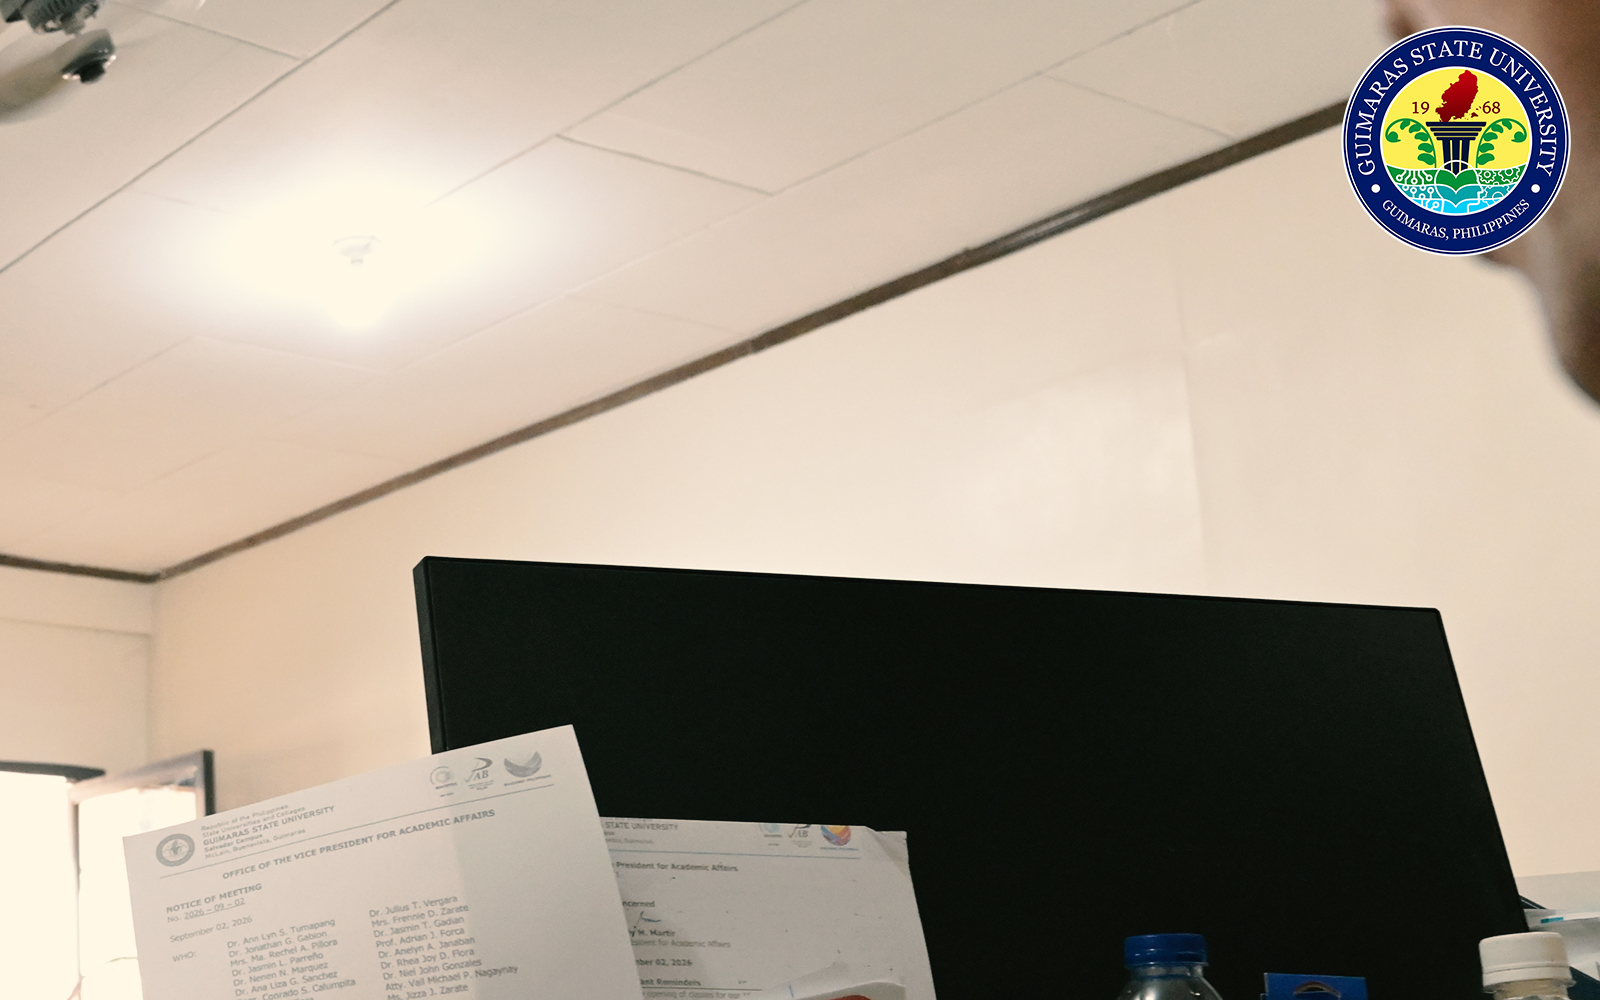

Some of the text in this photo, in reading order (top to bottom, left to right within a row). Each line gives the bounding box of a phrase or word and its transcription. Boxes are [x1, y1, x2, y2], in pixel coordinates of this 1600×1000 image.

[202, 830, 219, 838] State
[276, 807, 305, 817] Colleges
[203, 805, 334, 845] GUIMARAS STATE UNIVERSITY
[631, 822, 678, 830] UNIVERSITY
[205, 834, 262, 852] Salvador Campus
[222, 809, 495, 879] OFFICE OF THE VICE PRESIDENT FOR ACADEMIC AFFAIRS
[711, 863, 738, 872] Affairs
[166, 883, 262, 913] NOTICE OF MEETING
[369, 896, 458, 918] Dr. Julius T. Vergara
[167, 897, 245, 923] No. 2026 09 02
[372, 920, 390, 928] Mrs.
[428, 910, 438, 918] D.
[441, 904, 469, 916] Zarate
[170, 915, 253, 943] September 02, 2026
[243, 936, 259, 944] Ann
[261, 932, 277, 940] Lyn
[279, 928, 287, 936] S.
[373, 916, 464, 938] Dr. Jasmin T. Gadian
[245, 941, 282, 954] Jonathan
[285, 937, 294, 945] G.
[376, 939, 397, 948] Prof.
[400, 934, 428, 944] Adrian
[378, 951, 391, 959] Dr.
[427, 943, 436, 951] A.
[439, 937, 475, 949] Janaban
[172, 951, 197, 962] WHO:
[230, 959, 249, 967] Mrs.
[380, 962, 394, 970] Dr.
[397, 957, 419, 966] Rhea
[422, 955, 436, 963] Joy
[440, 952, 450, 960] D.
[232, 969, 245, 977] Dr.
[248, 961, 277, 974] Jasmin
[399, 968, 416, 978] Niel
[419, 965, 440, 975] John
[442, 958, 482, 971] Gonzales
[233, 978, 246, 987] Dr.
[235, 988, 249, 997] Dr.
[251, 985, 267, 993] Ana
[270, 980, 287, 989] Liza
[302, 971, 338, 983] Sanchez
[385, 983, 406, 992] Atty.
[428, 973, 461, 985] Michael
[463, 971, 473, 979] P.
[440, 984, 469, 994] Zarate
[262, 990, 299, 1000] Conrado
[301, 986, 310, 994] S.
